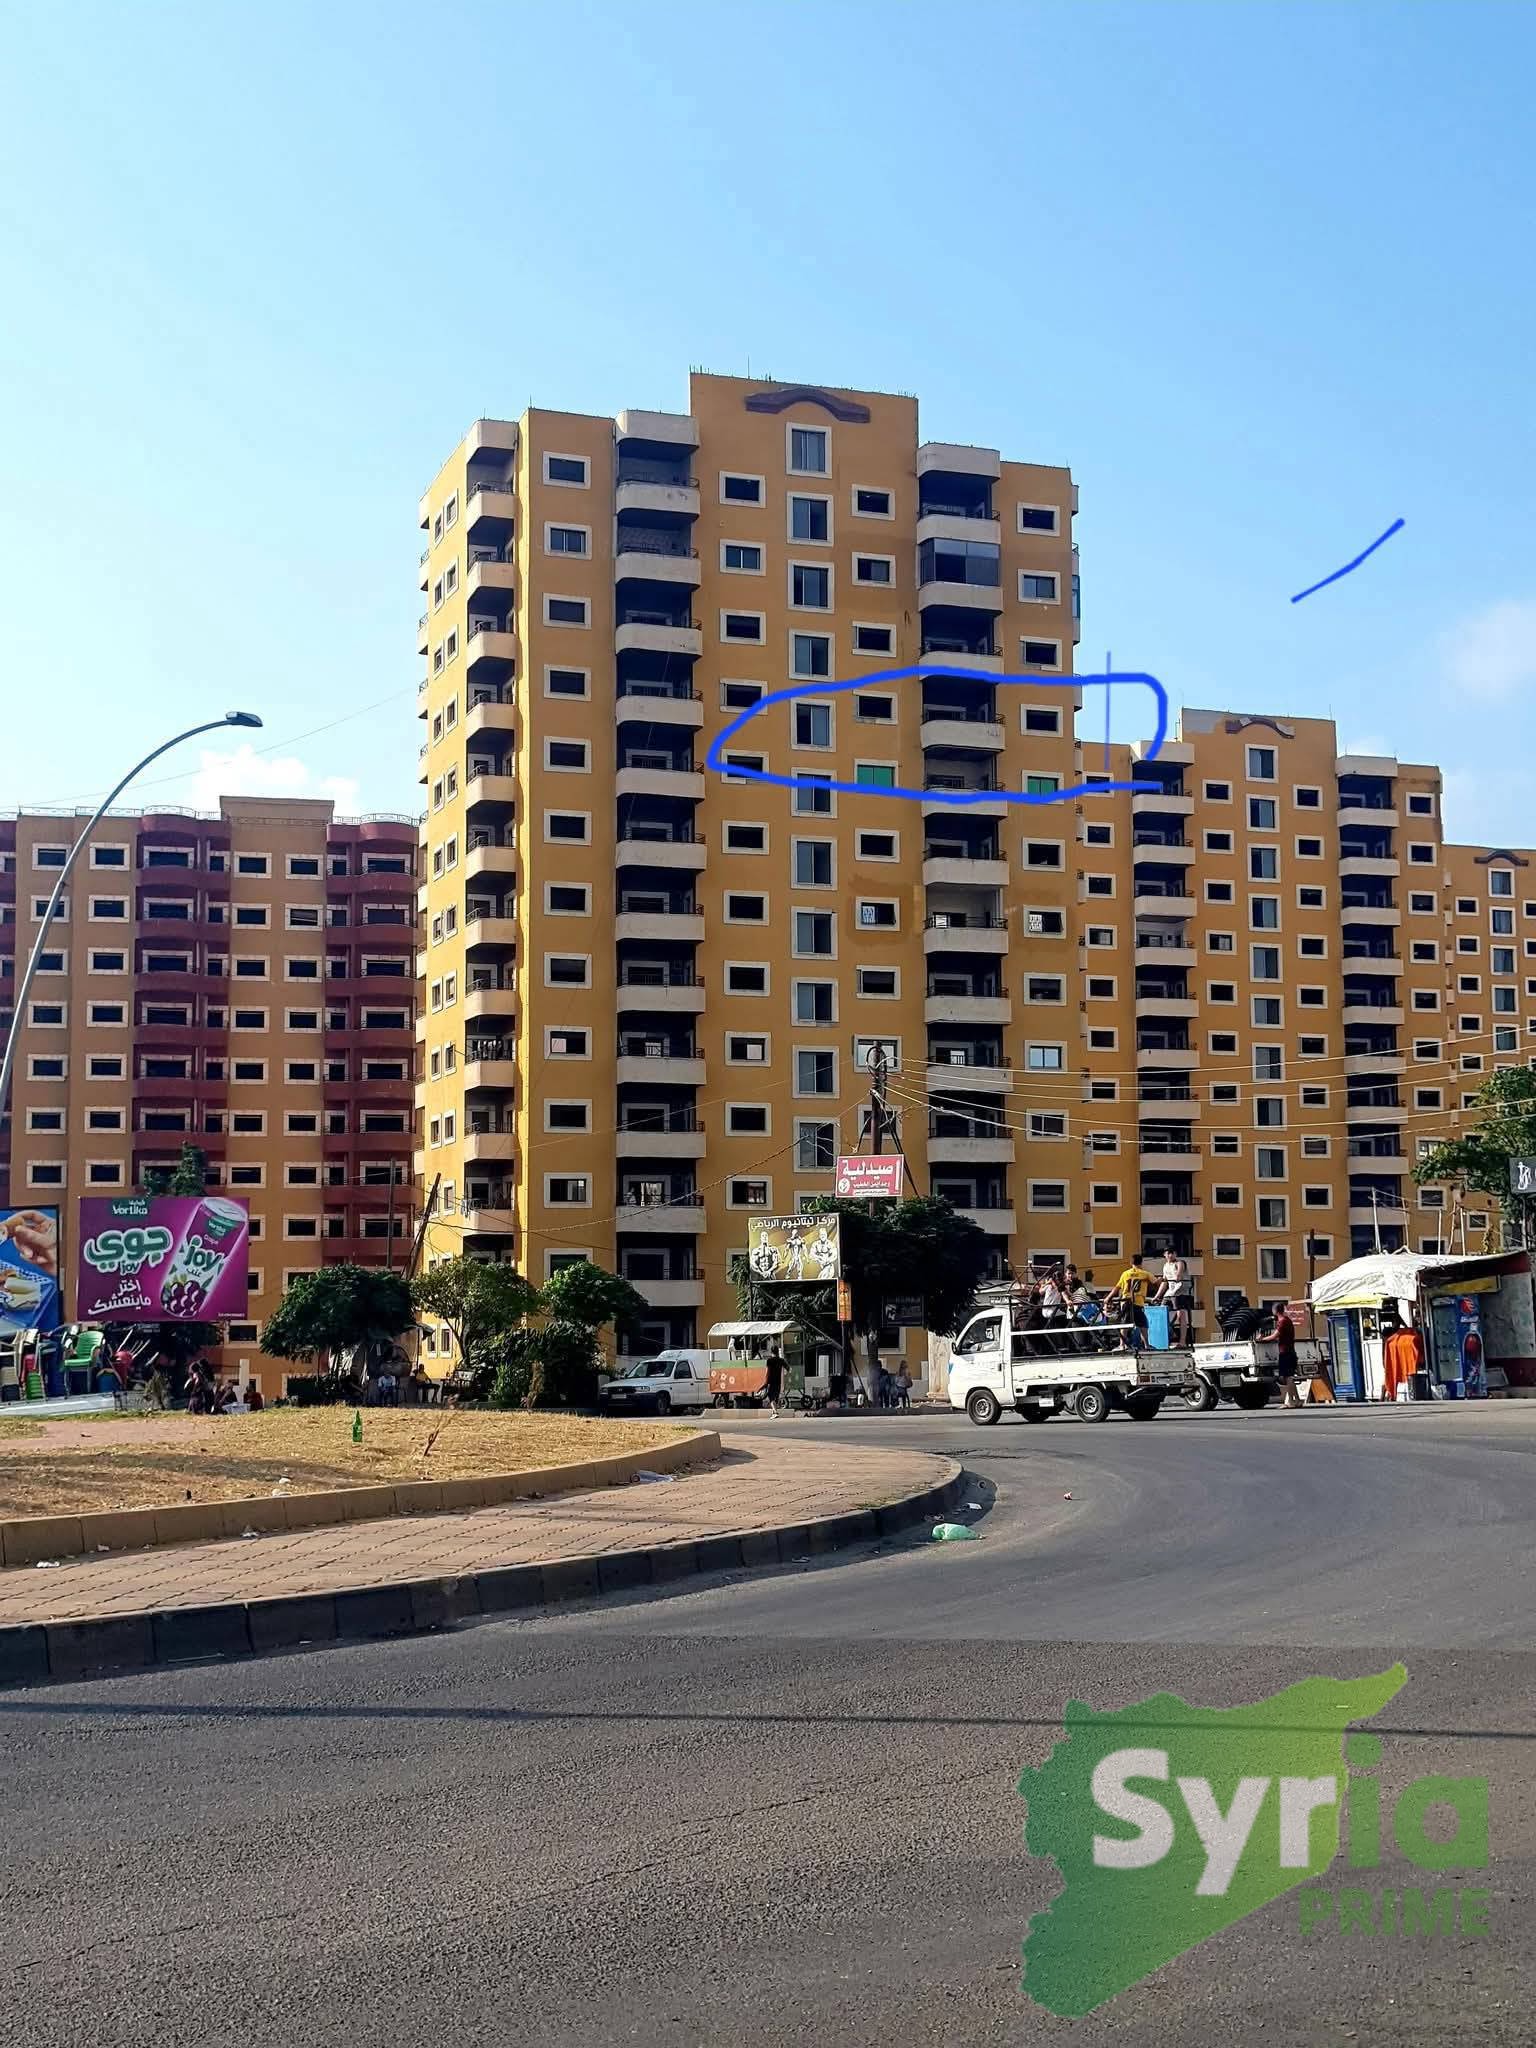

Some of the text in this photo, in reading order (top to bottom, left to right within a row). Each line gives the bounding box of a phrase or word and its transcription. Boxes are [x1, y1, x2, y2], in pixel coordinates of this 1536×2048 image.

[842, 1159, 894, 1181] صيدلية
[751, 1218, 779, 1232] الرياضي
[816, 1216, 836, 1227] مركز
[84, 1227, 172, 1271] جوي
[183, 1235, 224, 1272] joy
[118, 1279, 141, 1296] اختر
